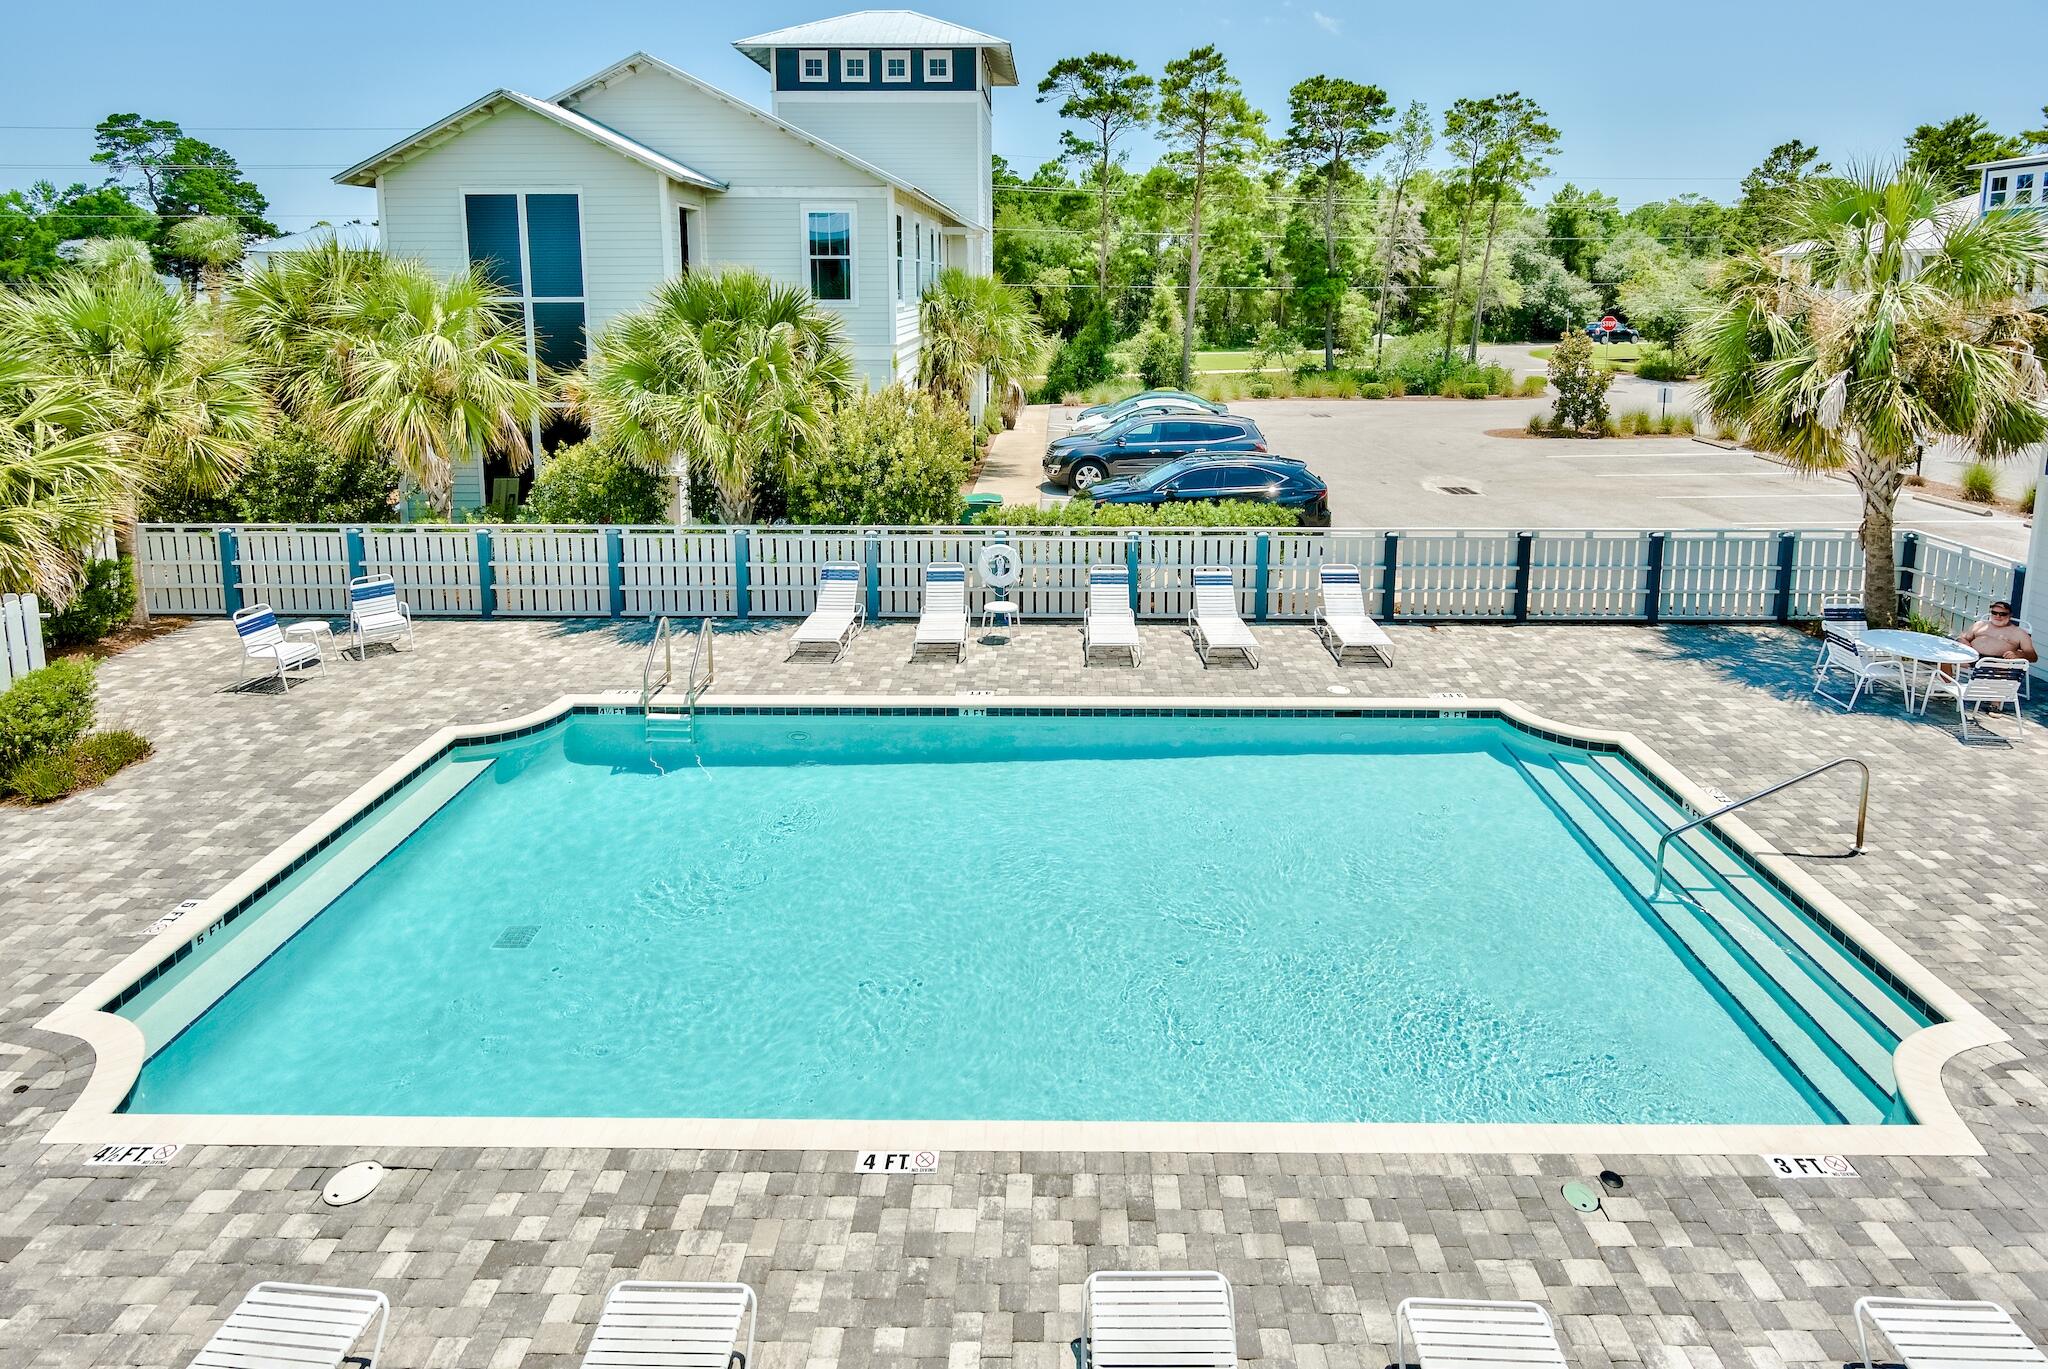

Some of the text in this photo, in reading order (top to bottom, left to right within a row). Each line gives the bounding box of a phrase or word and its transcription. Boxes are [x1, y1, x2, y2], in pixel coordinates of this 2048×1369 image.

[209, 918, 223, 937] FT
[118, 1146, 154, 1162] FT.
[863, 1153, 911, 1170] 4 FT.
[1773, 1157, 1828, 1174] 3 FT.
